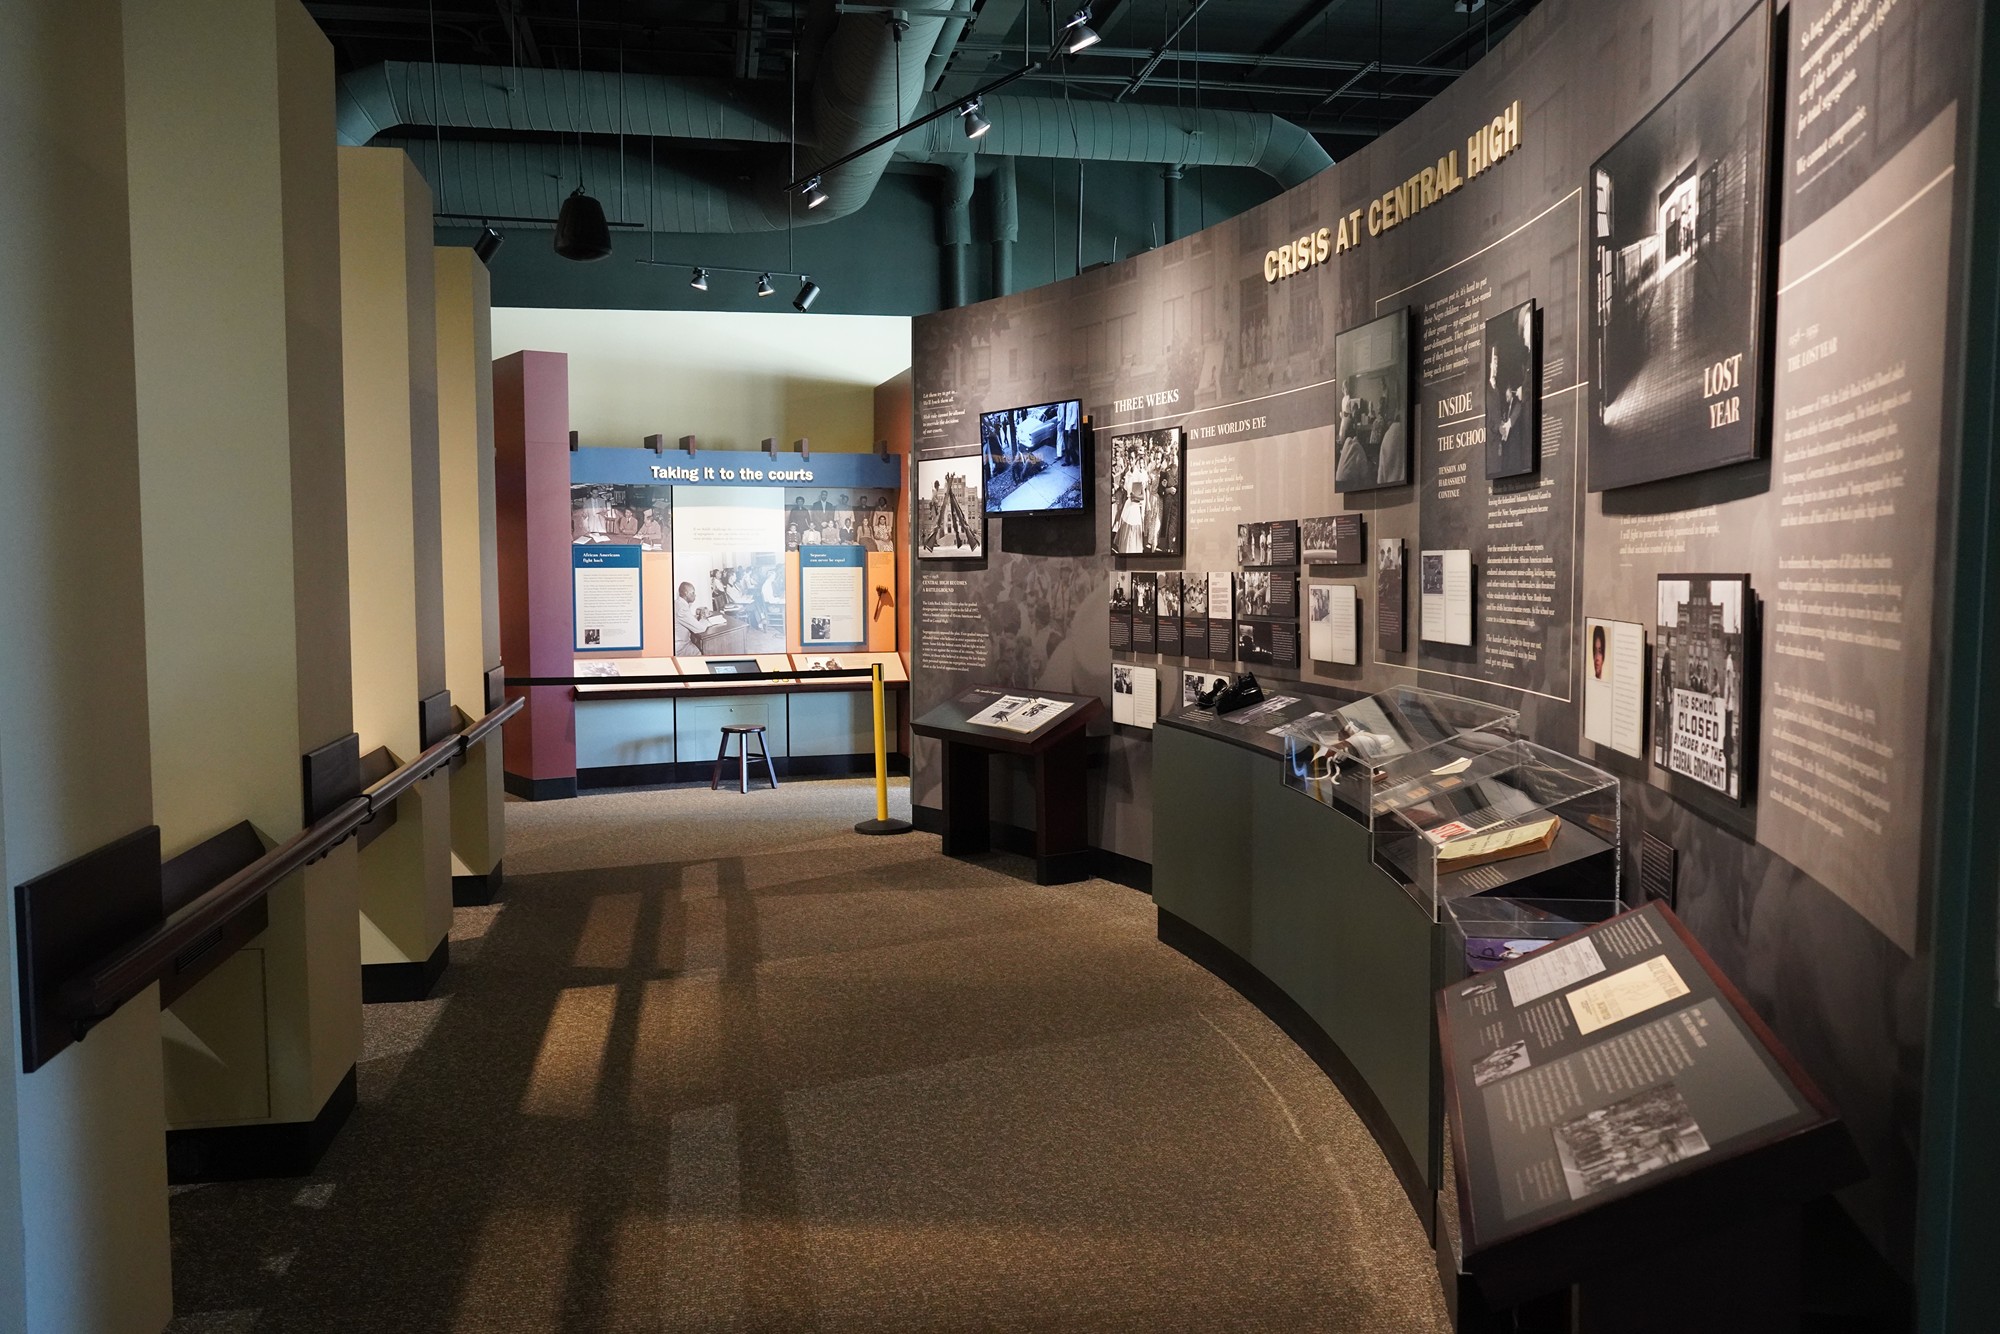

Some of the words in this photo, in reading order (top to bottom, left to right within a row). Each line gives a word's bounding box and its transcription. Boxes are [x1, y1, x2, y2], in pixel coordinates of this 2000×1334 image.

[1264, 227, 1331, 283] CRISIS
[1336, 208, 1364, 255] AT
[1368, 150, 1463, 237] CENTRAL
[1467, 100, 1522, 179] HIGH
[1787, 354, 1801, 373] THE
[1801, 345, 1819, 367] LOST
[1819, 337, 1838, 359] YEAR
[1703, 352, 1743, 399] LOST
[1114, 395, 1145, 413] THREE
[1146, 388, 1180, 407] WEEKS
[1438, 391, 1473, 419] INSIDE
[1709, 396, 1740, 429] YEAR
[1190, 428, 1199, 440] IN
[1200, 426, 1217, 438] THE
[1217, 419, 1251, 436] WORLD'S
[1251, 416, 1268, 429] EYE
[1438, 435, 1455, 452] THE
[651, 466, 699, 481] Taking
[719, 467, 736, 480] to
[739, 468, 764, 480] the
[768, 469, 814, 481] courts
[1438, 476, 1467, 487] HARASSMENT
[1439, 465, 1457, 475] TENSION
[1457, 463, 1468, 473] AND
[1438, 489, 1460, 500] CONTINUE
[1677, 693, 1689, 708] THIS
[1691, 697, 1718, 717] SCHOOL
[1679, 711, 1719, 743] CLOSED
[1674, 732, 1680, 745] BY
[1680, 735, 1699, 753] ORDER
[1701, 743, 1710, 755] OF
[1711, 745, 1724, 762] THE
[1673, 748, 1692, 775] FEDERAL
